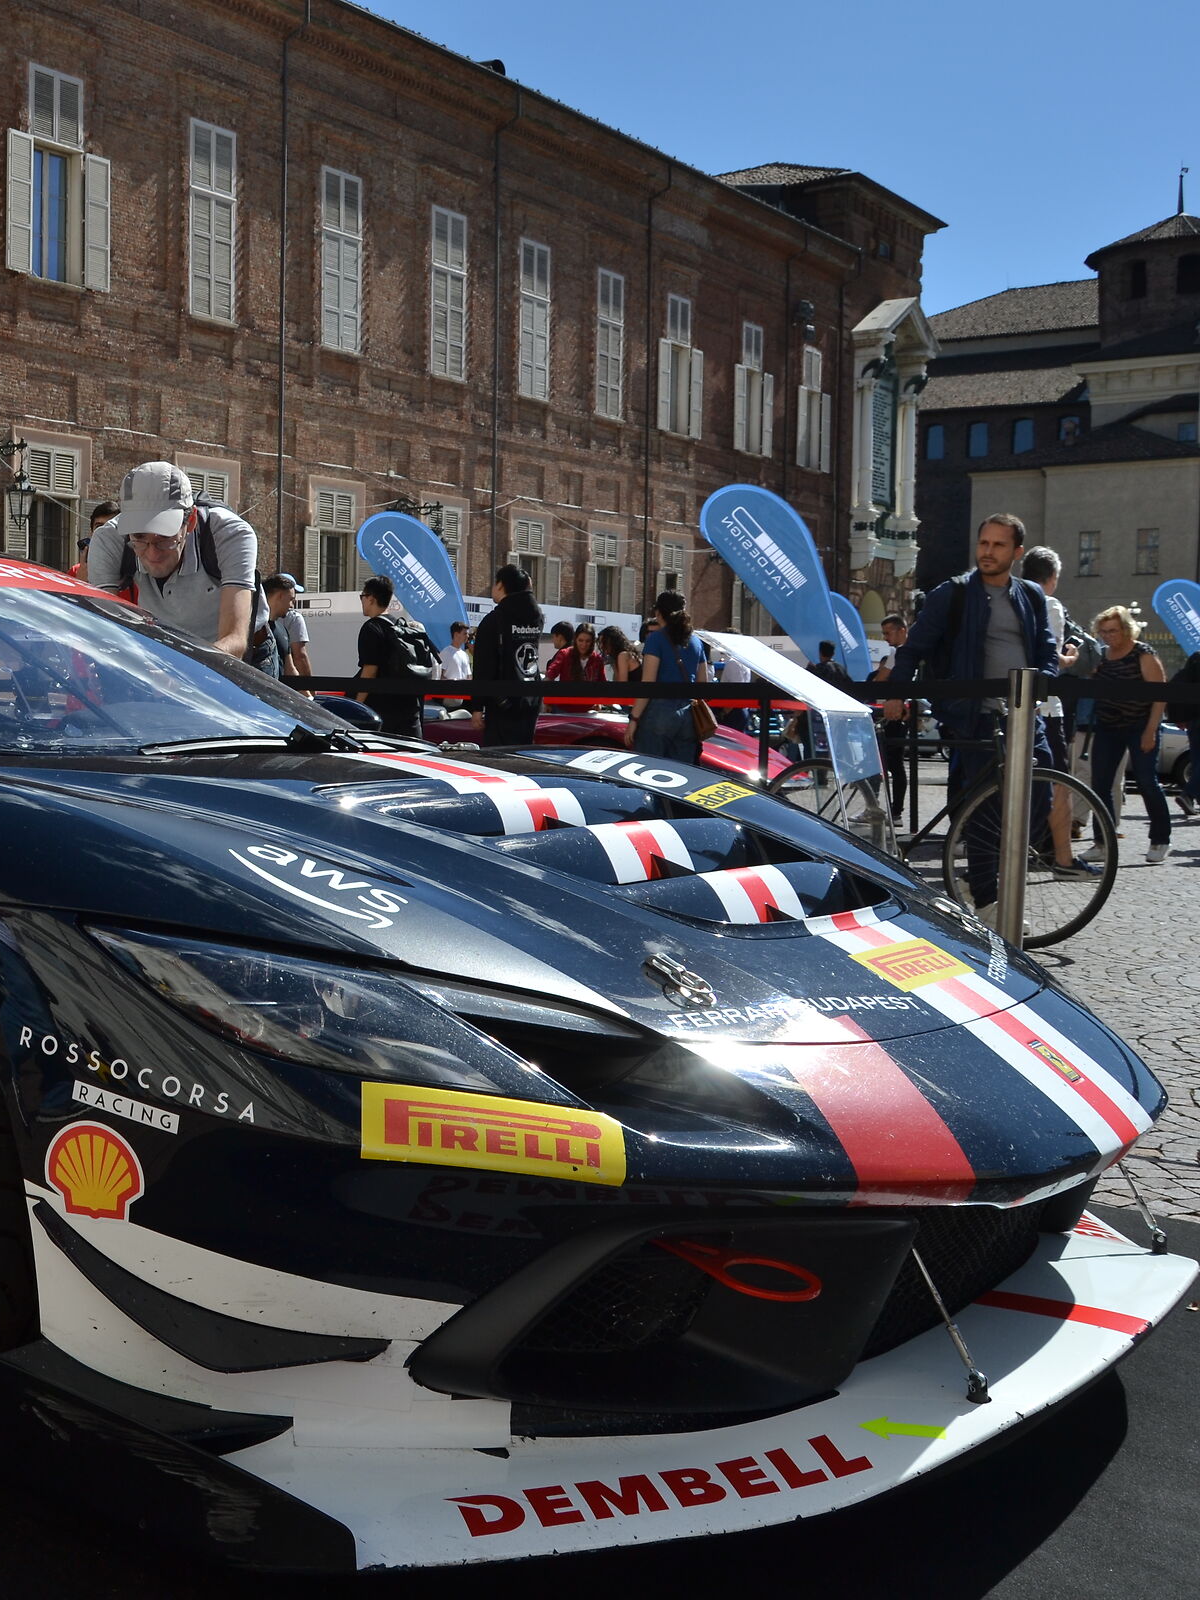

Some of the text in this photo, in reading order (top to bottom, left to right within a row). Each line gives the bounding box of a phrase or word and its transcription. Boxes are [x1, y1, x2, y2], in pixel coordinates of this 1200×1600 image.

[247, 844, 409, 914] aws
[867, 945, 958, 982] PIRELLI
[19, 1026, 256, 1123] ROSSOCORSA
[79, 1085, 172, 1130] RACING
[384, 1098, 601, 1169] PIRELLI
[446, 1434, 874, 1538] DEMBELL
